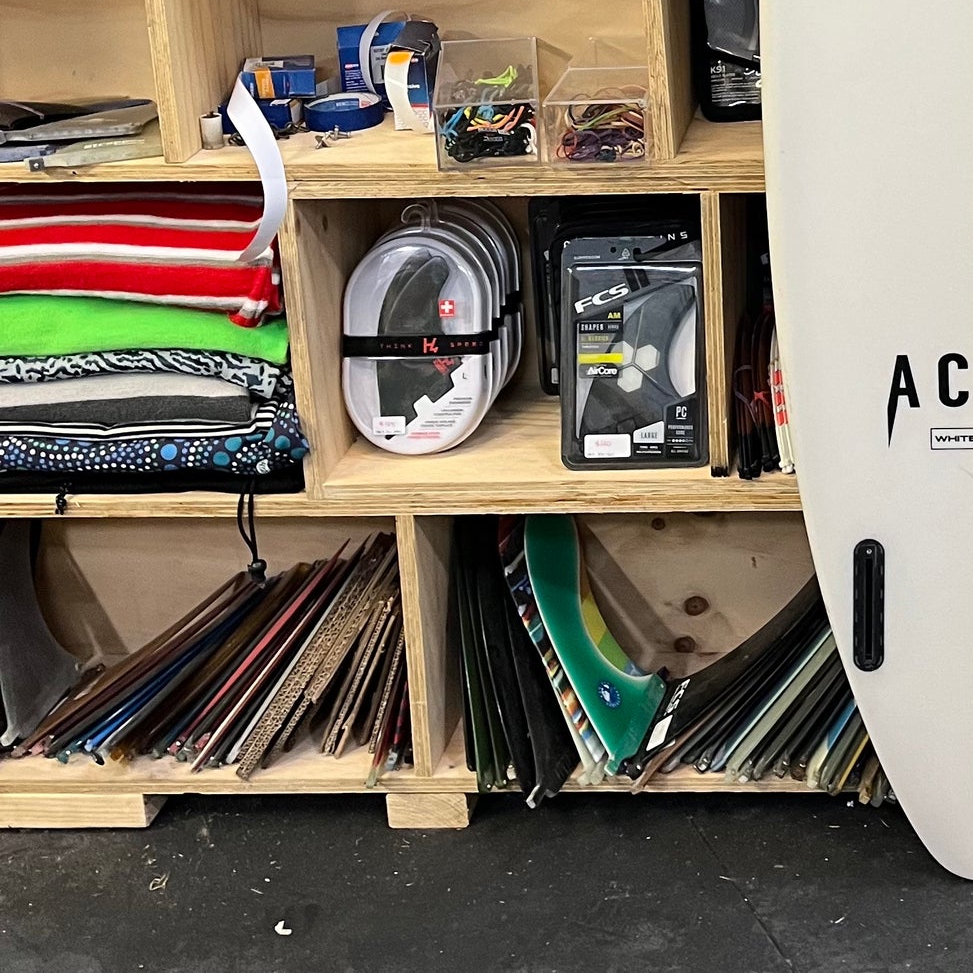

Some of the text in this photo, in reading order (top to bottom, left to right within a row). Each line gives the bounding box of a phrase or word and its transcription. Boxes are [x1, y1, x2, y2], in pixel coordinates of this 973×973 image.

[574, 283, 629, 314] FCS
[607, 311, 621, 319] AM
[580, 323, 604, 331] SHAPER
[586, 366, 618, 376] AirCore
[675, 406, 688, 418] PC
[640, 431, 658, 440] LARGE
